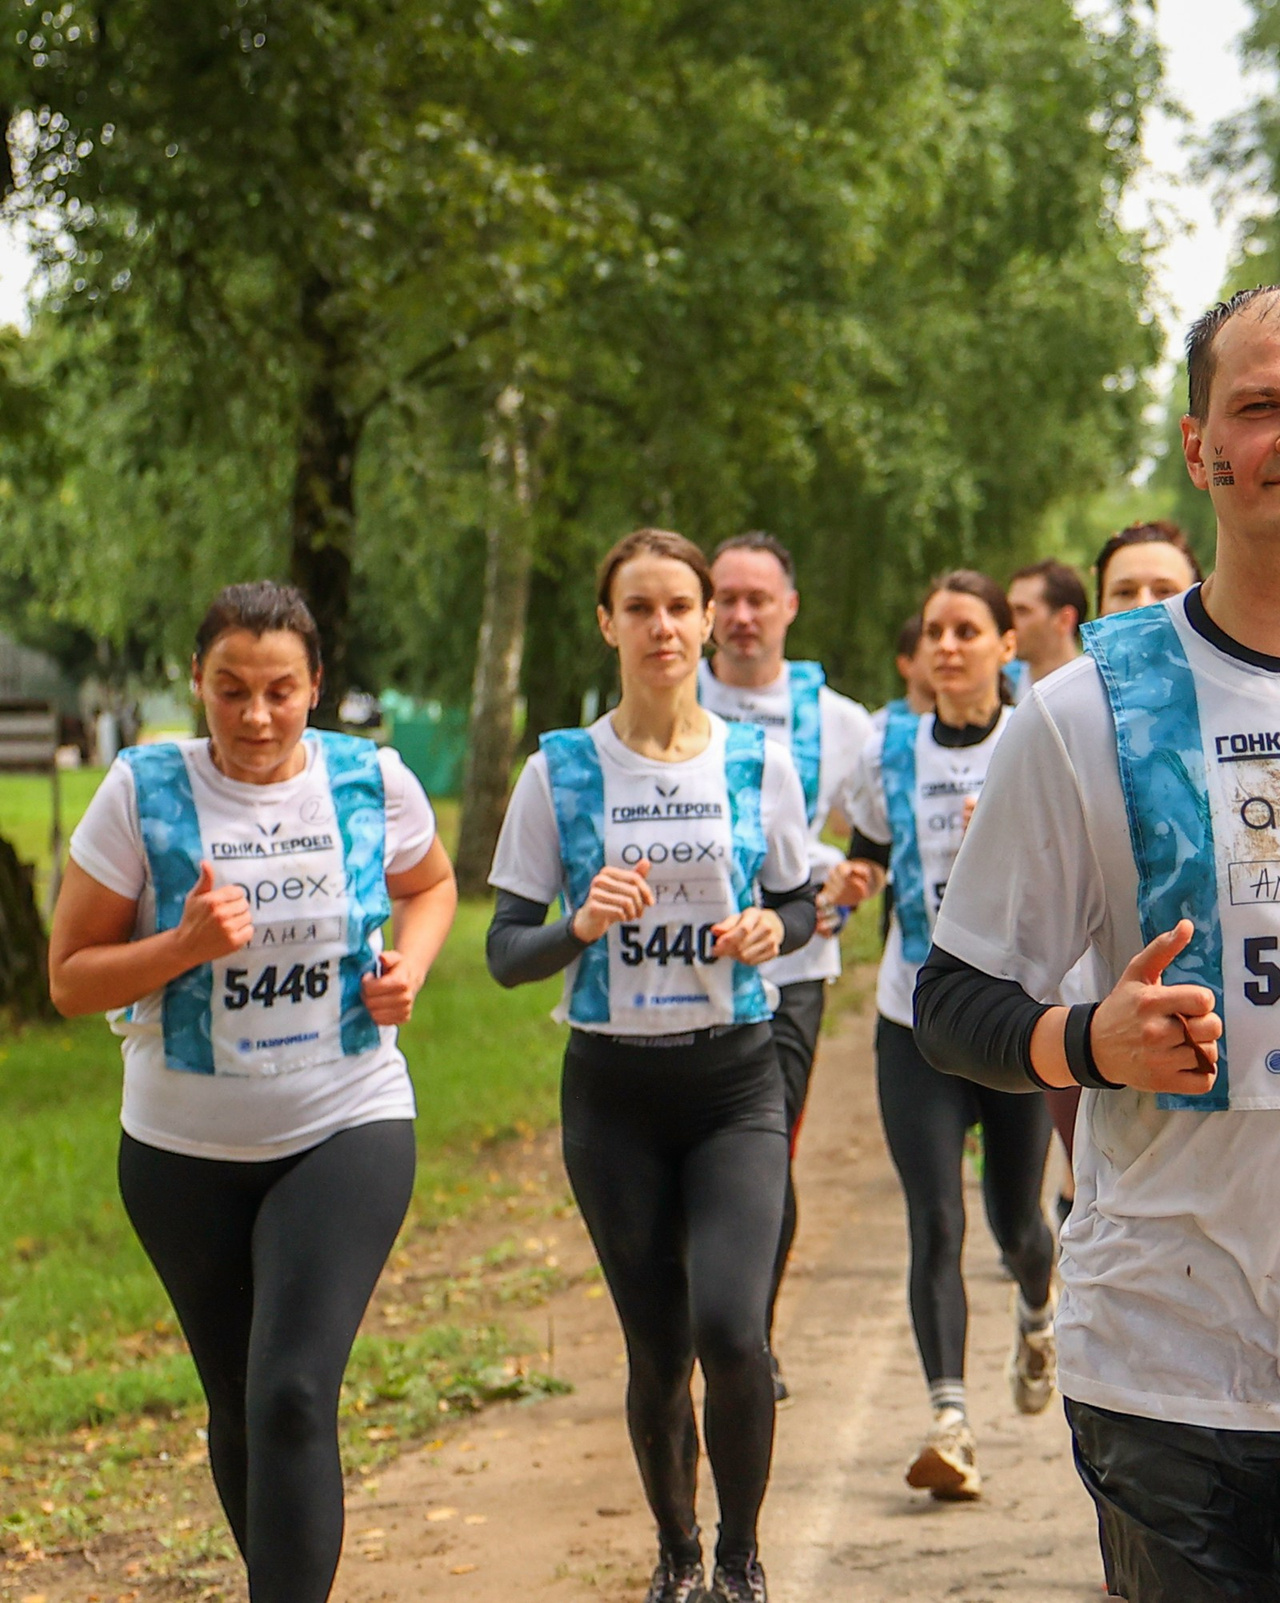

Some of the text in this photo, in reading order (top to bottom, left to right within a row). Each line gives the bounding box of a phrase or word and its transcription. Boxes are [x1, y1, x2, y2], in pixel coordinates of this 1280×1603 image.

[211, 841, 266, 856] ГОНКА
[620, 923, 719, 966] 5440
[224, 960, 330, 1011] 5446
